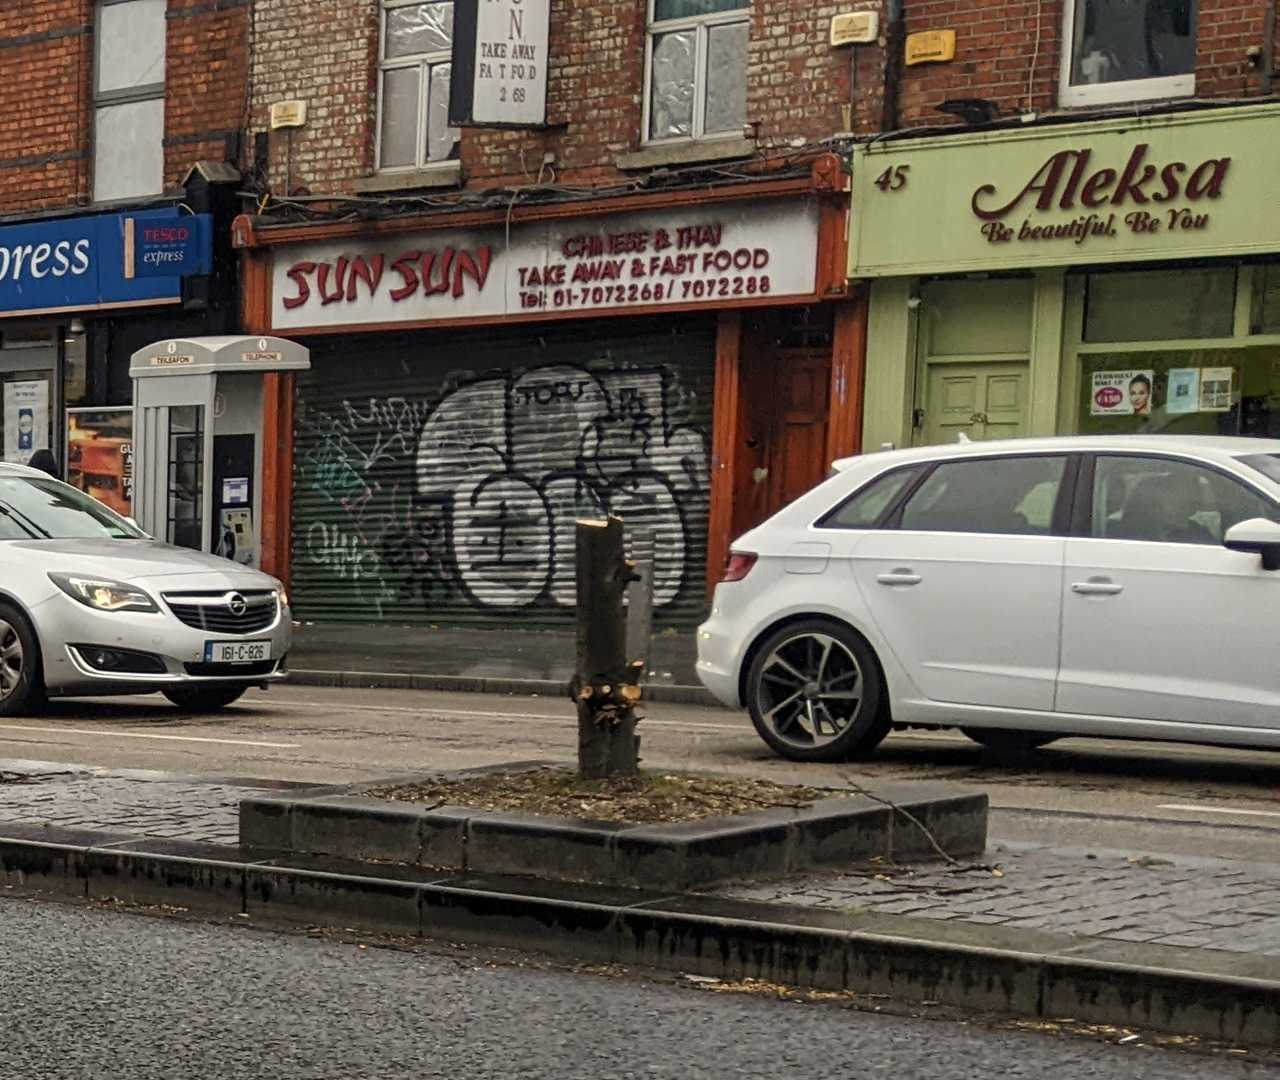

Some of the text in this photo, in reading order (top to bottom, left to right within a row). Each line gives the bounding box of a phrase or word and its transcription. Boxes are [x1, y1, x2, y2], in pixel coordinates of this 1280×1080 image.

[481, 43, 536, 60] TAKE AWAY
[874, 164, 910, 192] 45
[971, 143, 1232, 220] Aleksa
[144, 228, 189, 241] TESCO
[980, 208, 1209, 245] Be beautiful, Be You
[561, 223, 722, 259] CHINESE & THAI
[144, 250, 184, 266] express
[518, 248, 769, 286] TAKE AWAY & FAST FOOD
[283, 246, 492, 310] SUN SUN
[519, 291, 548, 308] Tel:
[222, 645, 264, 660] 161-C-826
